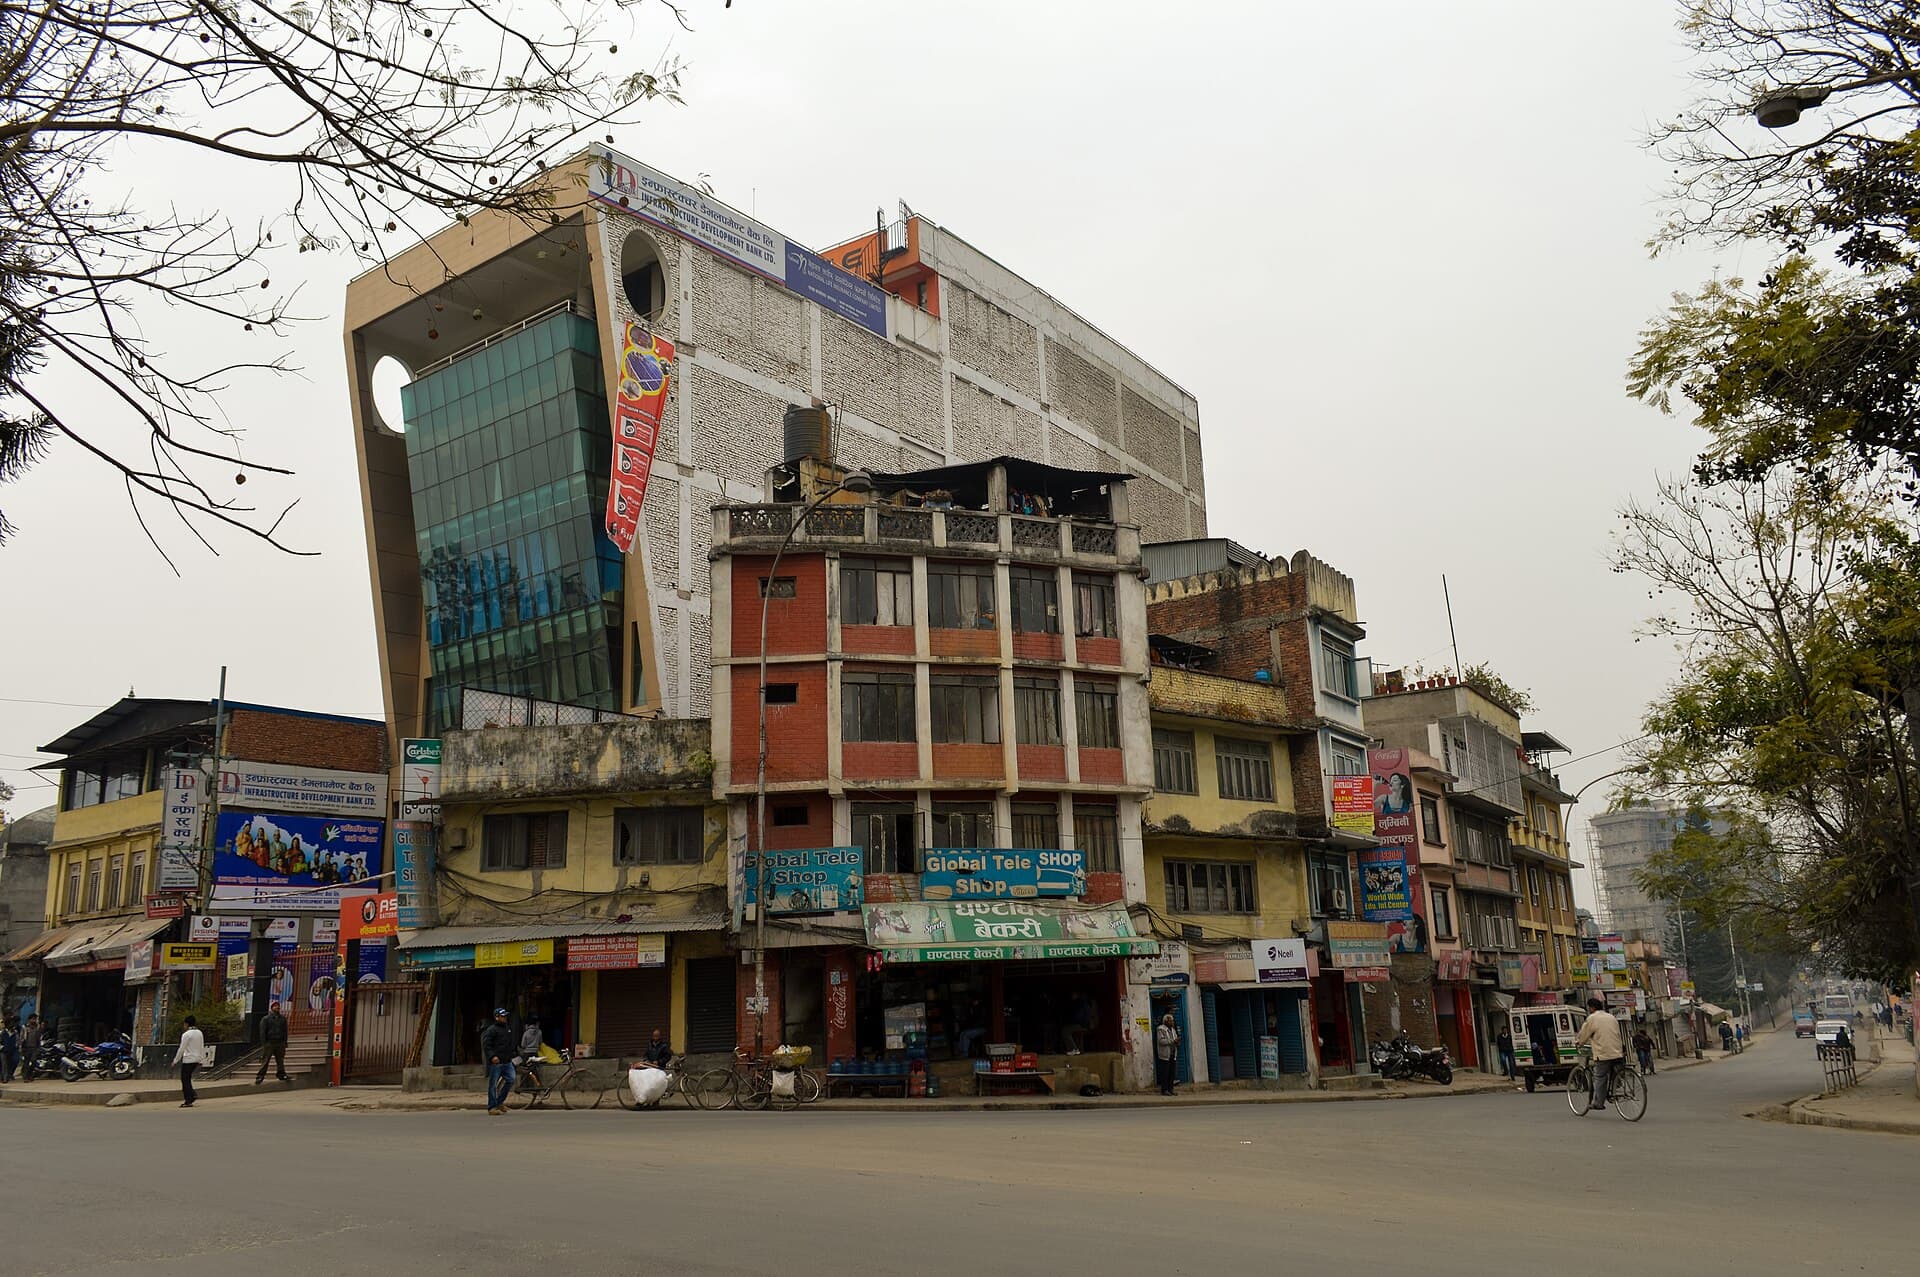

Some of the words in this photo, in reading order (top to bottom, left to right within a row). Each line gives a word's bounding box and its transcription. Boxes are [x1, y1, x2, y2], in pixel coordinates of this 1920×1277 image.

[701, 220, 745, 248] DEVELOPMENT
[745, 243, 762, 258] BANK
[764, 253, 776, 264] LTD.
[405, 744, 441, 760] Carlsber
[245, 787, 299, 800] INFRASTRUCTURE
[301, 792, 344, 804] DEVELOPMENT
[346, 796, 363, 804] BANK
[364, 797, 376, 806] LTD.
[405, 804, 441, 815] bounc
[397, 832, 433, 846] Global
[745, 850, 809, 868] Gobal
[814, 849, 860, 866] Tele
[926, 855, 987, 872] Global
[992, 855, 1032, 870] Tele
[1039, 852, 1082, 866] SHOP
[774, 870, 828, 886] Shop
[955, 878, 1007, 896] Shop
[1366, 893, 1387, 901] World
[1387, 892, 1405, 900] Wide
[380, 898, 398, 912] AS
[923, 921, 946, 935] Sprite
[973, 918, 1043, 939] बेकरी
[1108, 917, 1128, 930] Sprite
[926, 950, 971, 960] घण्टाघर
[973, 948, 1004, 959] बेकरी
[1049, 945, 1090, 957] घण्टाघर
[1093, 943, 1121, 955] बेकरी
[1277, 950, 1294, 958] Ncell
